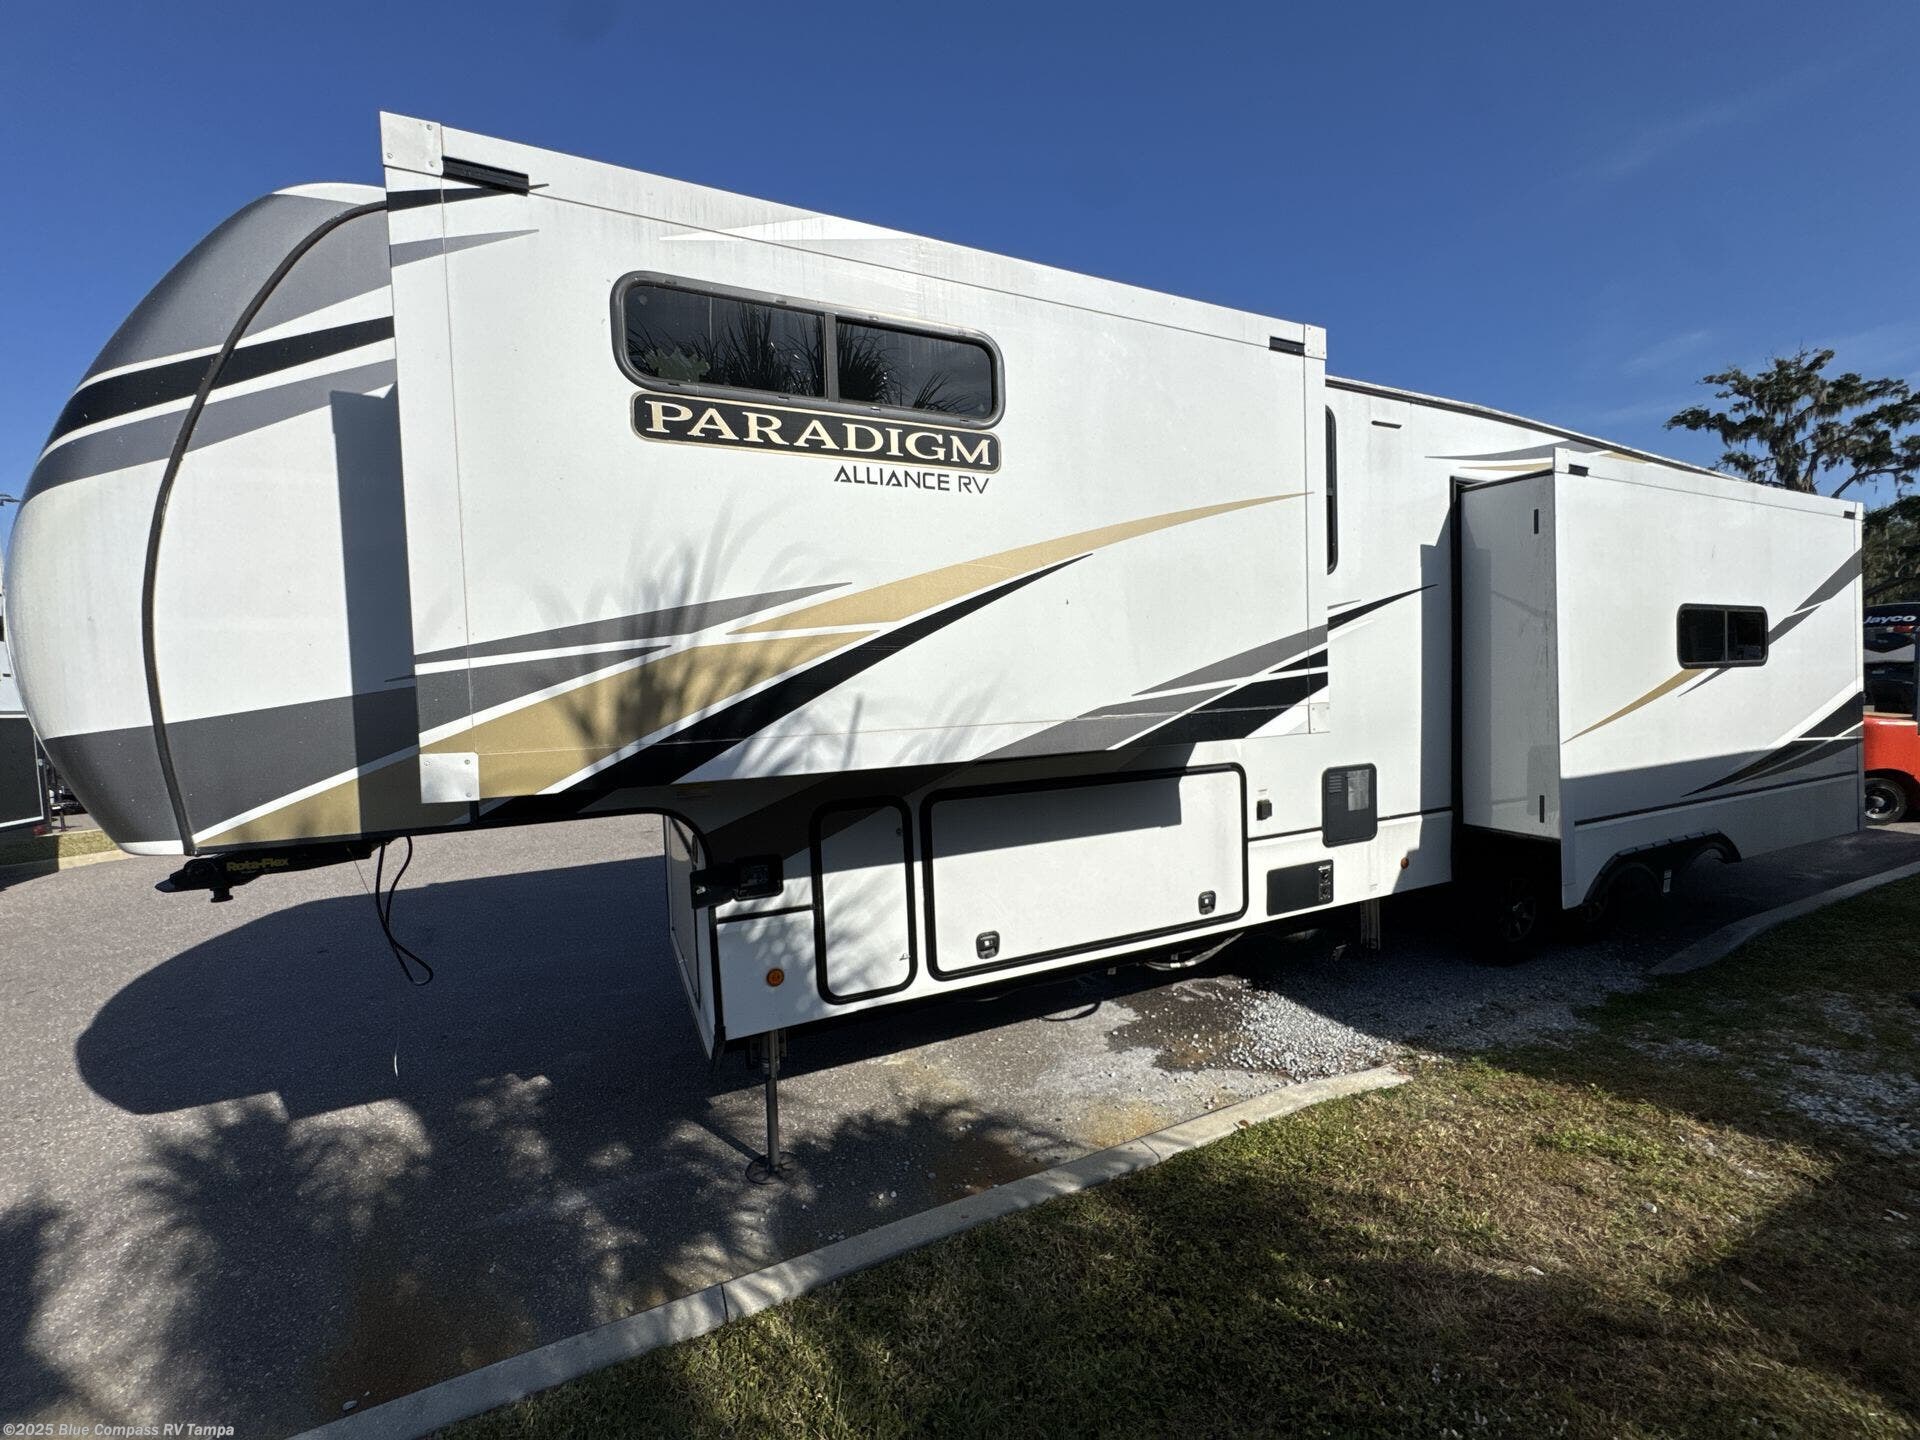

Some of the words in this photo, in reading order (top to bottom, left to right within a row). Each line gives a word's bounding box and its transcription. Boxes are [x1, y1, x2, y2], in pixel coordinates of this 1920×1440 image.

[644, 400, 992, 466] PARADIGM
[834, 465, 951, 491] ALLIANCE
[958, 475, 990, 494] RV
[1864, 615, 1917, 624] Jayco
